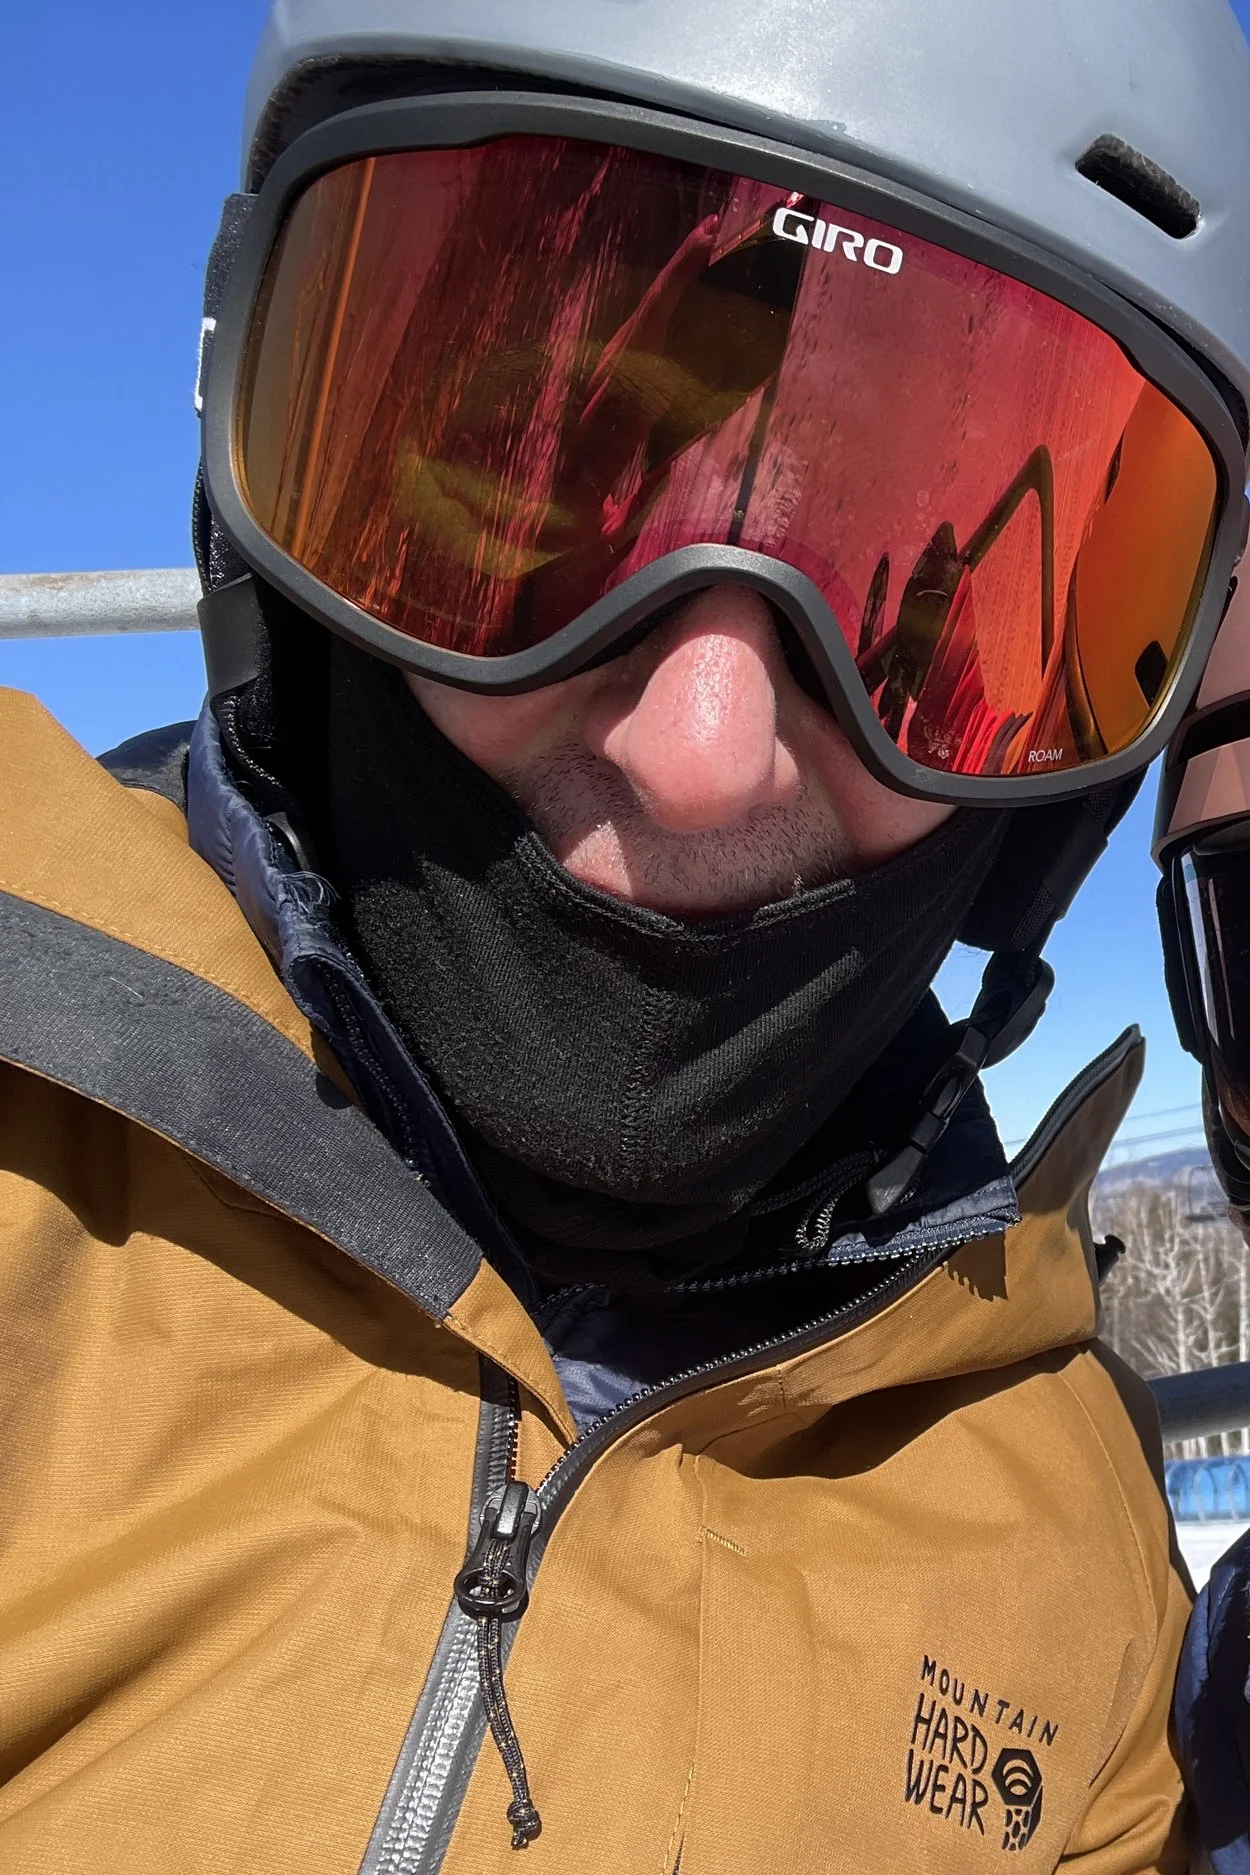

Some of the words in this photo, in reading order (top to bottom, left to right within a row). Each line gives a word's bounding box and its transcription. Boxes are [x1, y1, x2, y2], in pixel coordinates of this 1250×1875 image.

[772, 207, 903, 275] GIRO
[1028, 749, 1063, 763] ROAM
[911, 1692, 988, 1775] HARD
[921, 1655, 1058, 1746] MOUNTAIN
[904, 1748, 989, 1836] WEAR
